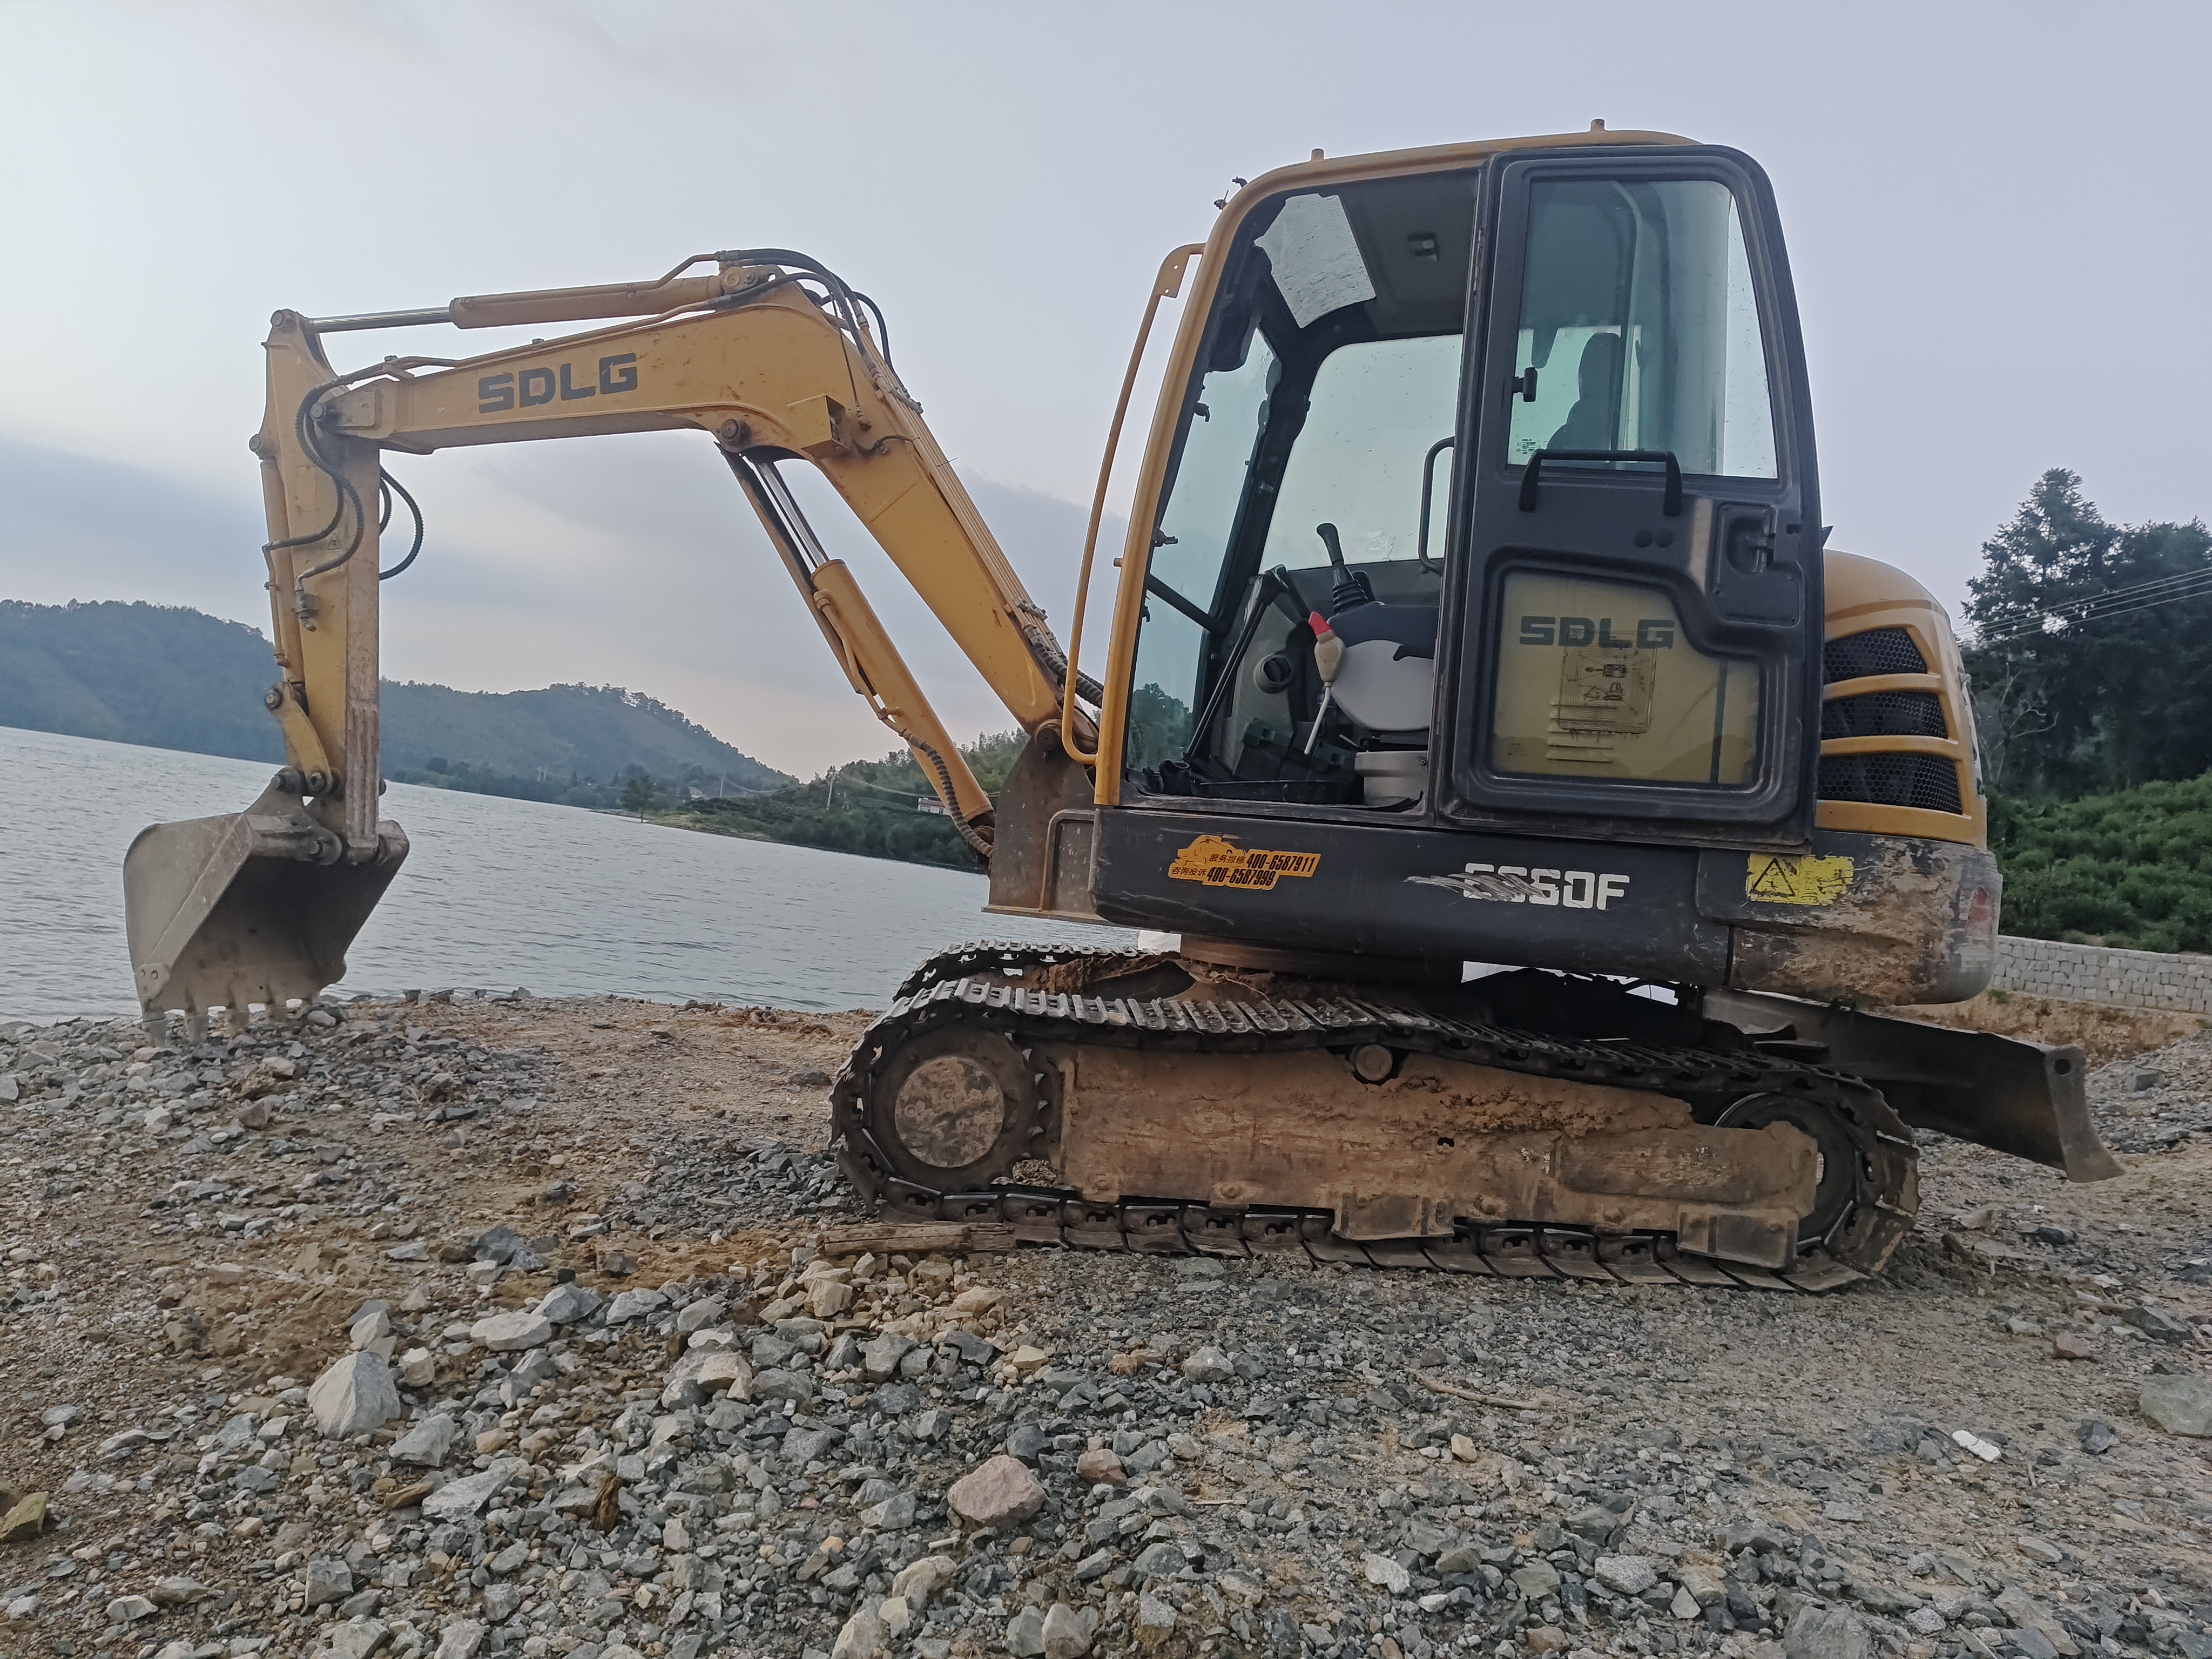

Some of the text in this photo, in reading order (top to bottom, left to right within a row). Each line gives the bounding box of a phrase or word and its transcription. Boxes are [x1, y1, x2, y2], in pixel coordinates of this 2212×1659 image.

[478, 353, 638, 414] SDLG
[1520, 616, 1675, 650] SDLG
[1172, 867, 1208, 876] 咨询投诉
[1209, 854, 1316, 872] 服务报修 400-6587911
